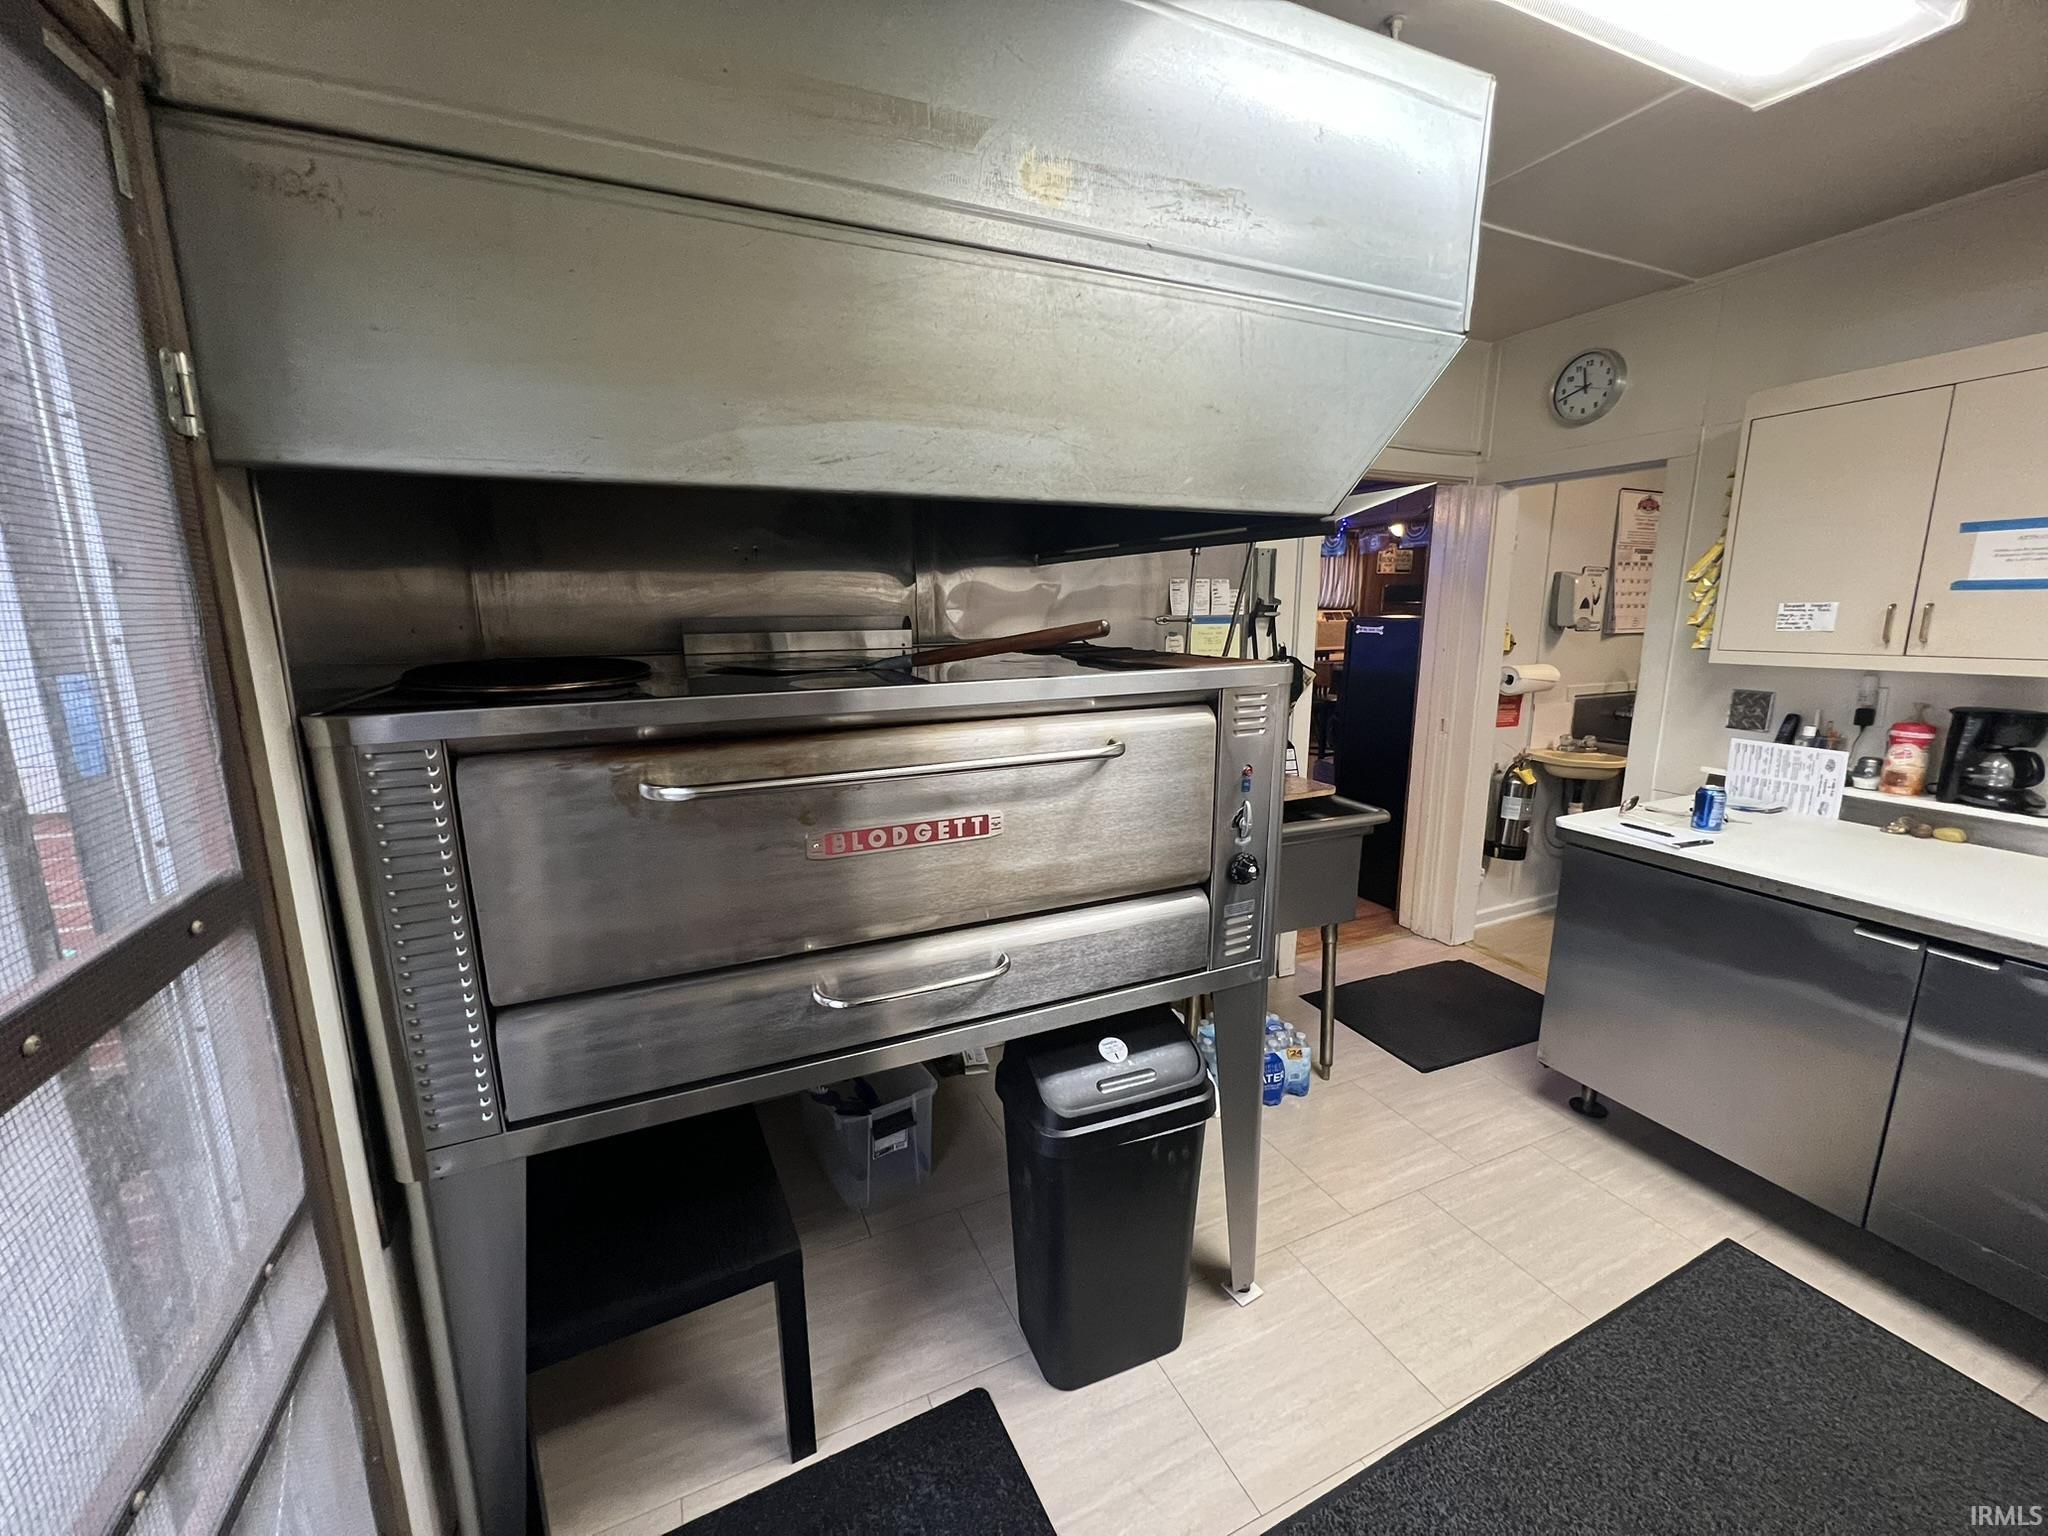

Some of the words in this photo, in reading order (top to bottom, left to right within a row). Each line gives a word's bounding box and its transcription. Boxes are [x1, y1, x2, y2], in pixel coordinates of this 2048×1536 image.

[1567, 376, 1575, 384] 10
[831, 816, 984, 854] BLODGETT
[1289, 1049, 1303, 1058] 24
